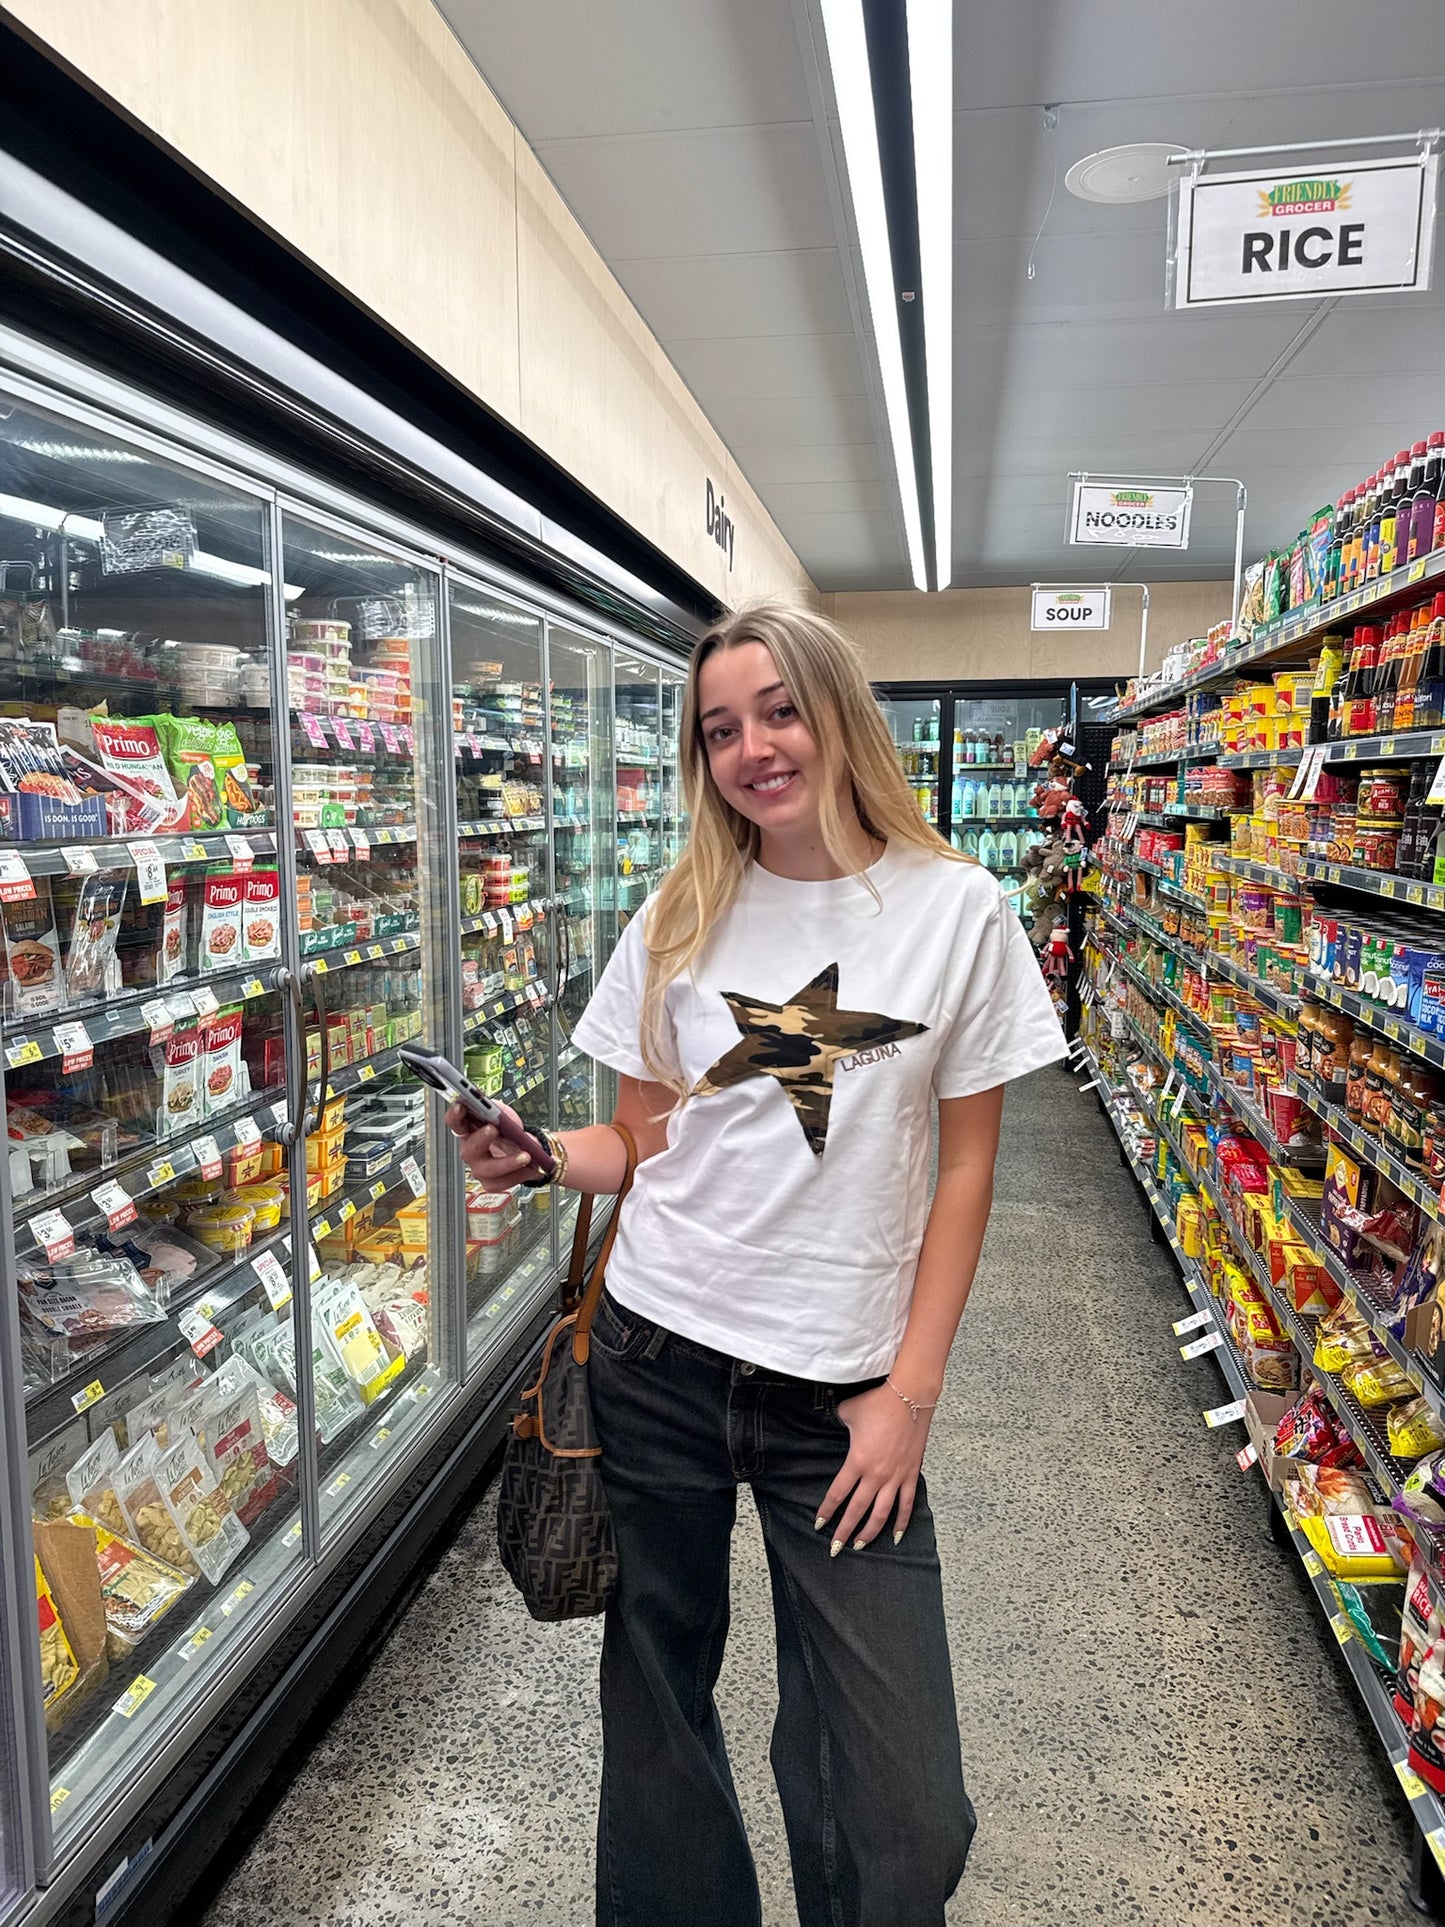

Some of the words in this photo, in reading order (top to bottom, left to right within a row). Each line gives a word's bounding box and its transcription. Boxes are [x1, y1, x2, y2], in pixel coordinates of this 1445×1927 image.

[1273, 180, 1339, 203] FRIENDLY
[1275, 201, 1332, 215] GROCER
[1241, 223, 1365, 274] RICE
[706, 477, 734, 572] Dairy
[1086, 512, 1177, 530] NOODLES
[1046, 608, 1093, 621] SOUP
[102, 735, 150, 756] Primo
[210, 885, 238, 904] Primo
[247, 881, 274, 898] Primo
[225, 909, 239, 917] STYLE
[208, 1026, 235, 1049] Primo
[168, 1040, 198, 1063] Primo
[841, 1043, 902, 1072] LAGUNA
[1412, 1588, 1433, 1616] RICE
